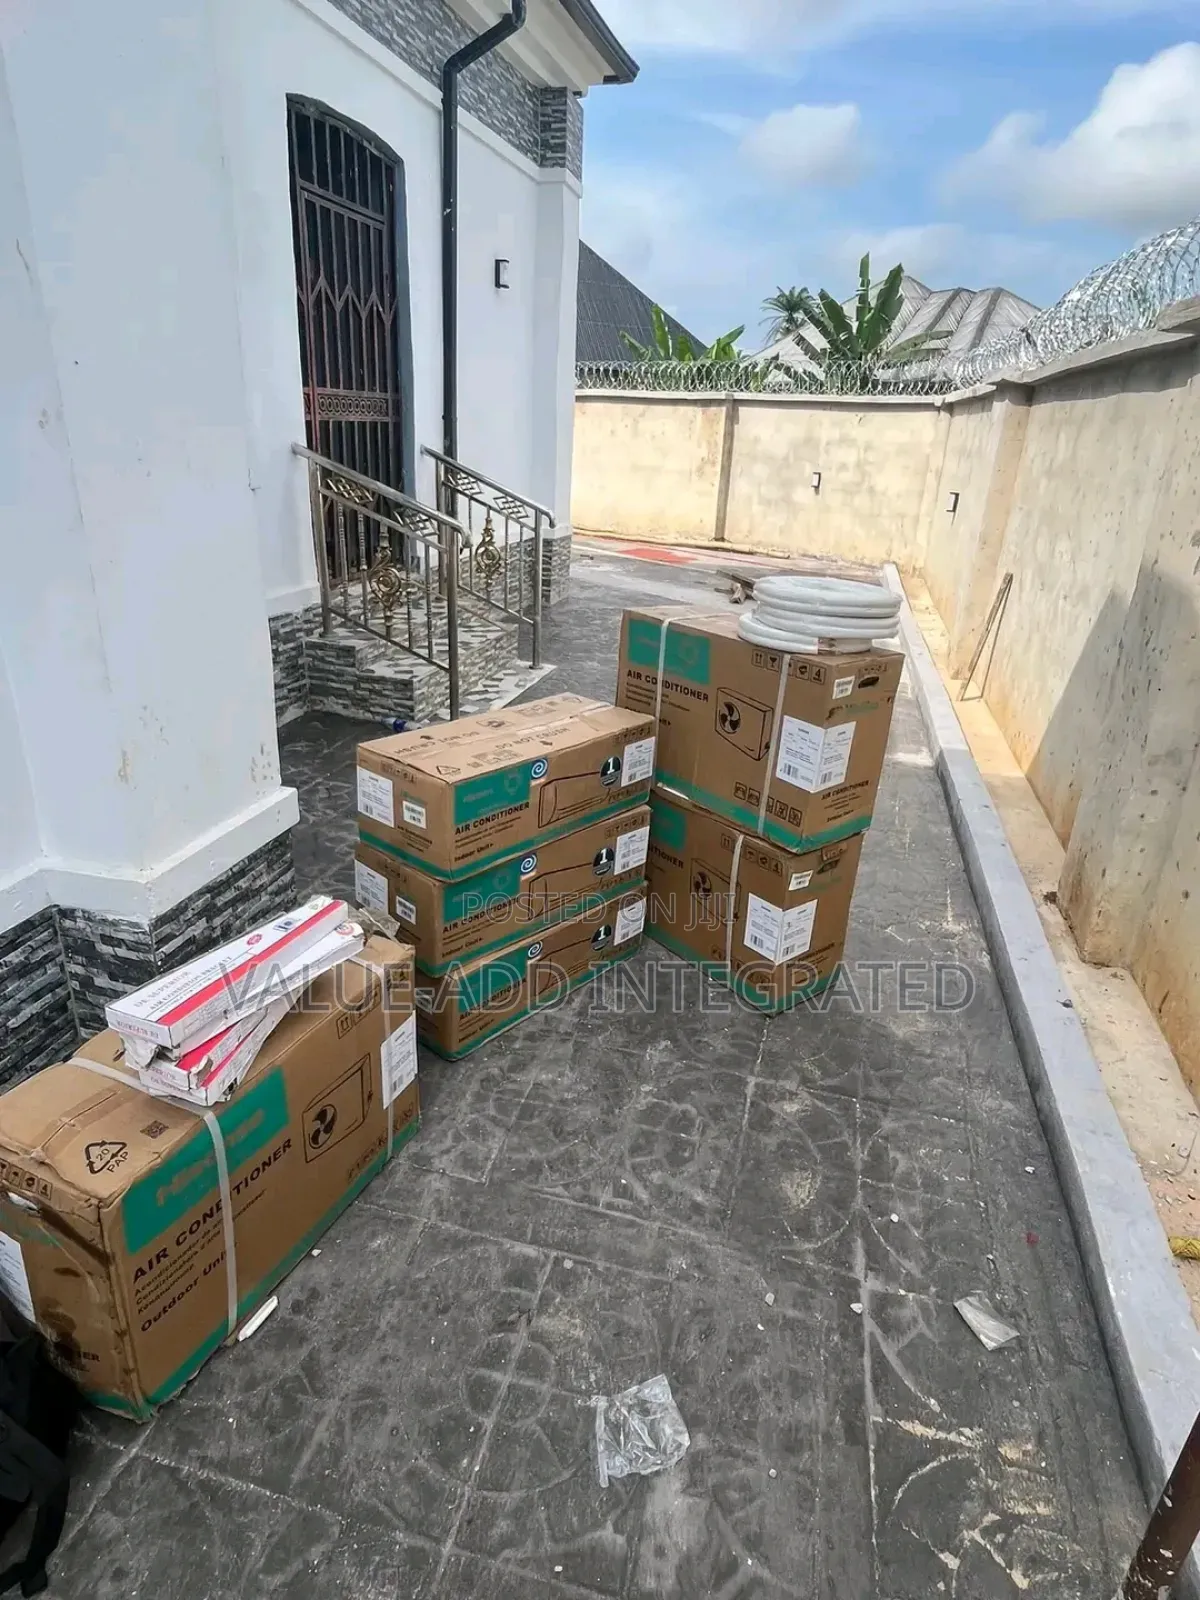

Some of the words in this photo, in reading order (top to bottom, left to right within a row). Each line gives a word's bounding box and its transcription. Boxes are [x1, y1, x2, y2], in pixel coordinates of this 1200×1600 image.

[627, 669, 642, 681] AIR
[644, 674, 709, 702] CODITIONER
[607, 757, 615, 774] 1
[455, 823, 471, 836] AIR
[472, 801, 530, 828] CONDITIONER
[600, 848, 608, 863] 1
[443, 922, 459, 934] AIR
[597, 925, 606, 940] 1
[96, 1148, 110, 1161] 20
[107, 1151, 128, 1173] PAP
[133, 1247, 170, 1284] AIR
[141, 1276, 200, 1331] Outdoor
[203, 1250, 226, 1276] Uni
